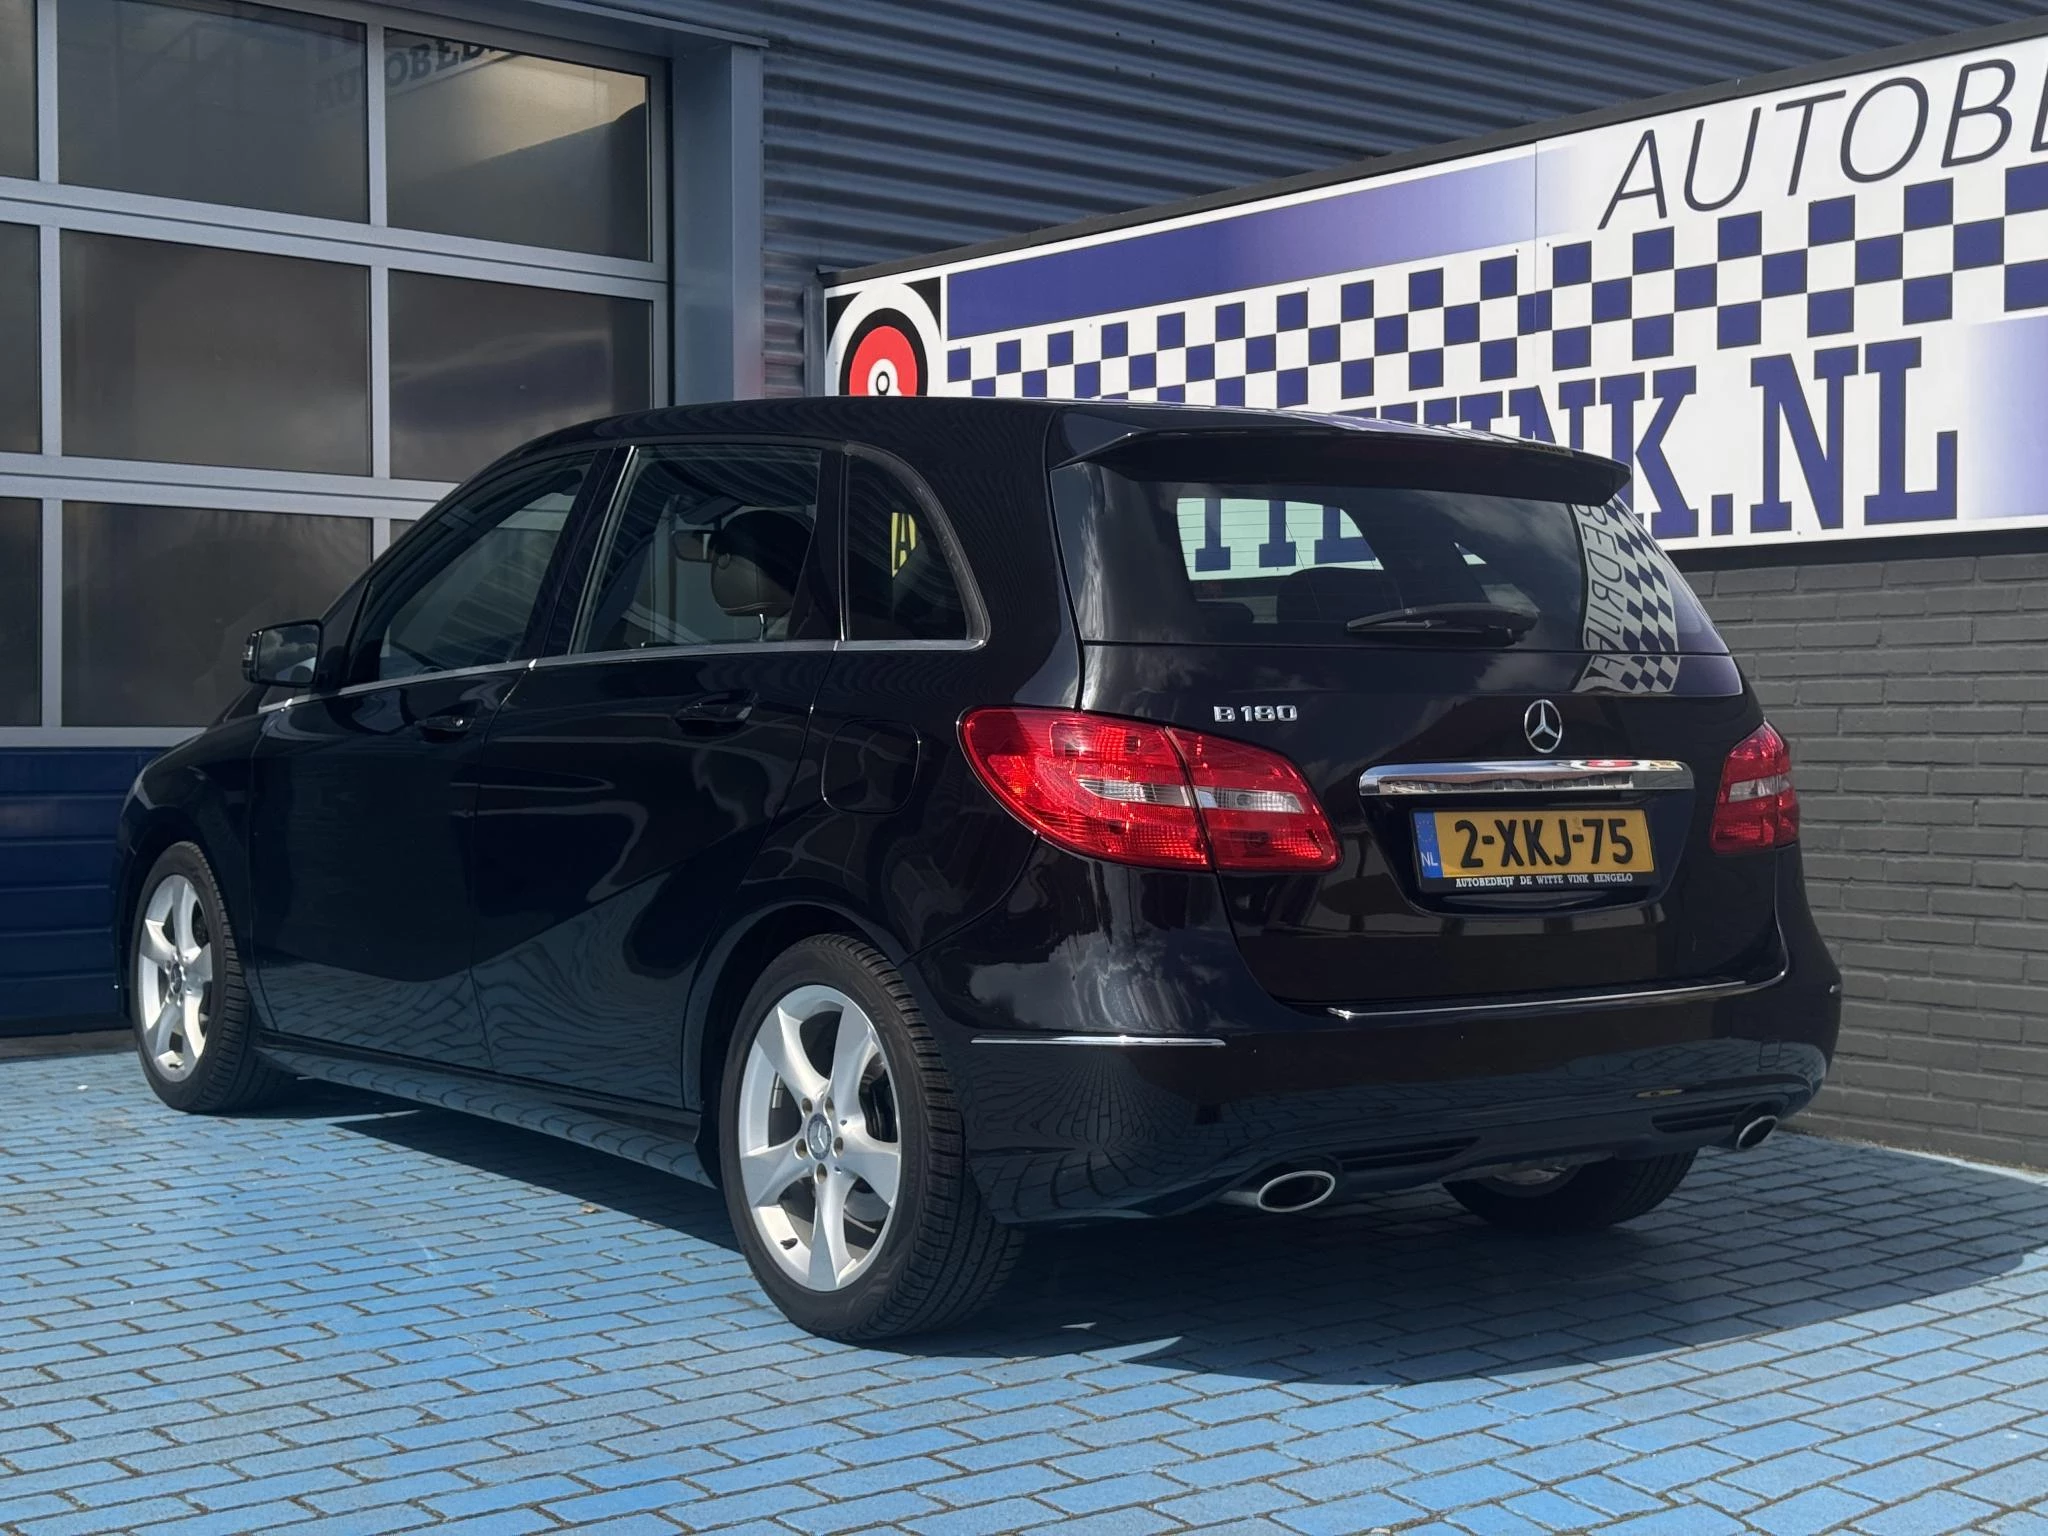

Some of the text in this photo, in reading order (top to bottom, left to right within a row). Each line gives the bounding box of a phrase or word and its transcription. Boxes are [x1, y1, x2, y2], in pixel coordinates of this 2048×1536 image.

[1213, 705, 1297, 722] B 180
[1454, 819, 1634, 868] 2-XKJ-75
[1420, 851, 1438, 867] NL
[1455, 873, 1633, 888] AUTOBEDRIJF DE WITTE VINK HENGELO
